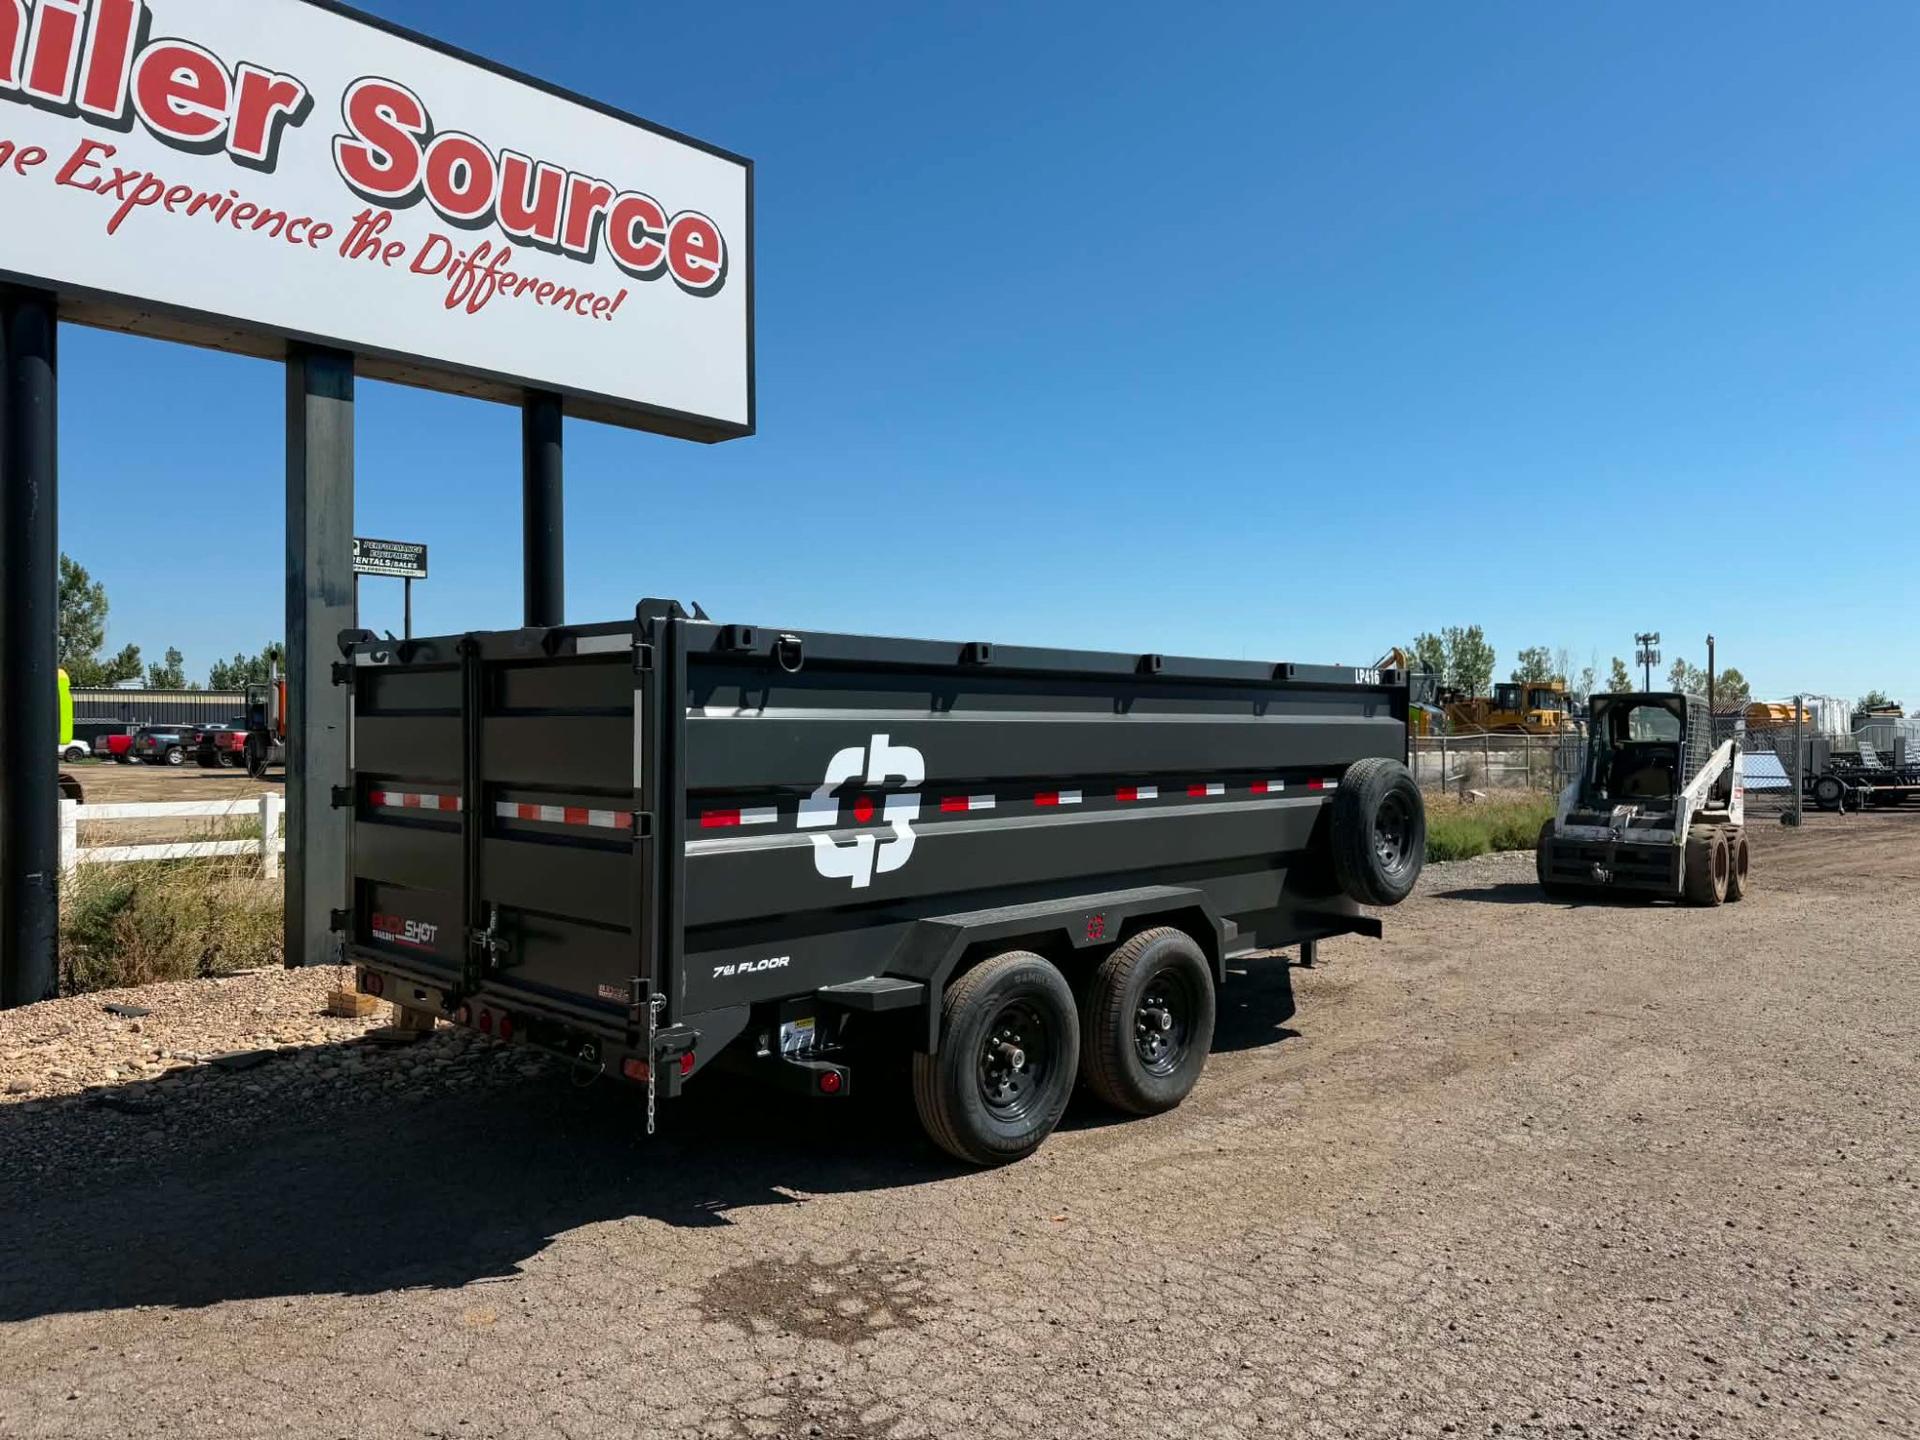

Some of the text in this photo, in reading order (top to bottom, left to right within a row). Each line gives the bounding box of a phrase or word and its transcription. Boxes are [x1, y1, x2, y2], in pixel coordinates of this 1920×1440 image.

[55, 138, 332, 246] Experience
[339, 208, 406, 266] the
[409, 233, 628, 321] Difference!
[332, 74, 729, 298] Source
[1355, 668, 1380, 685] LP416
[737, 956, 790, 974] FLOOR
